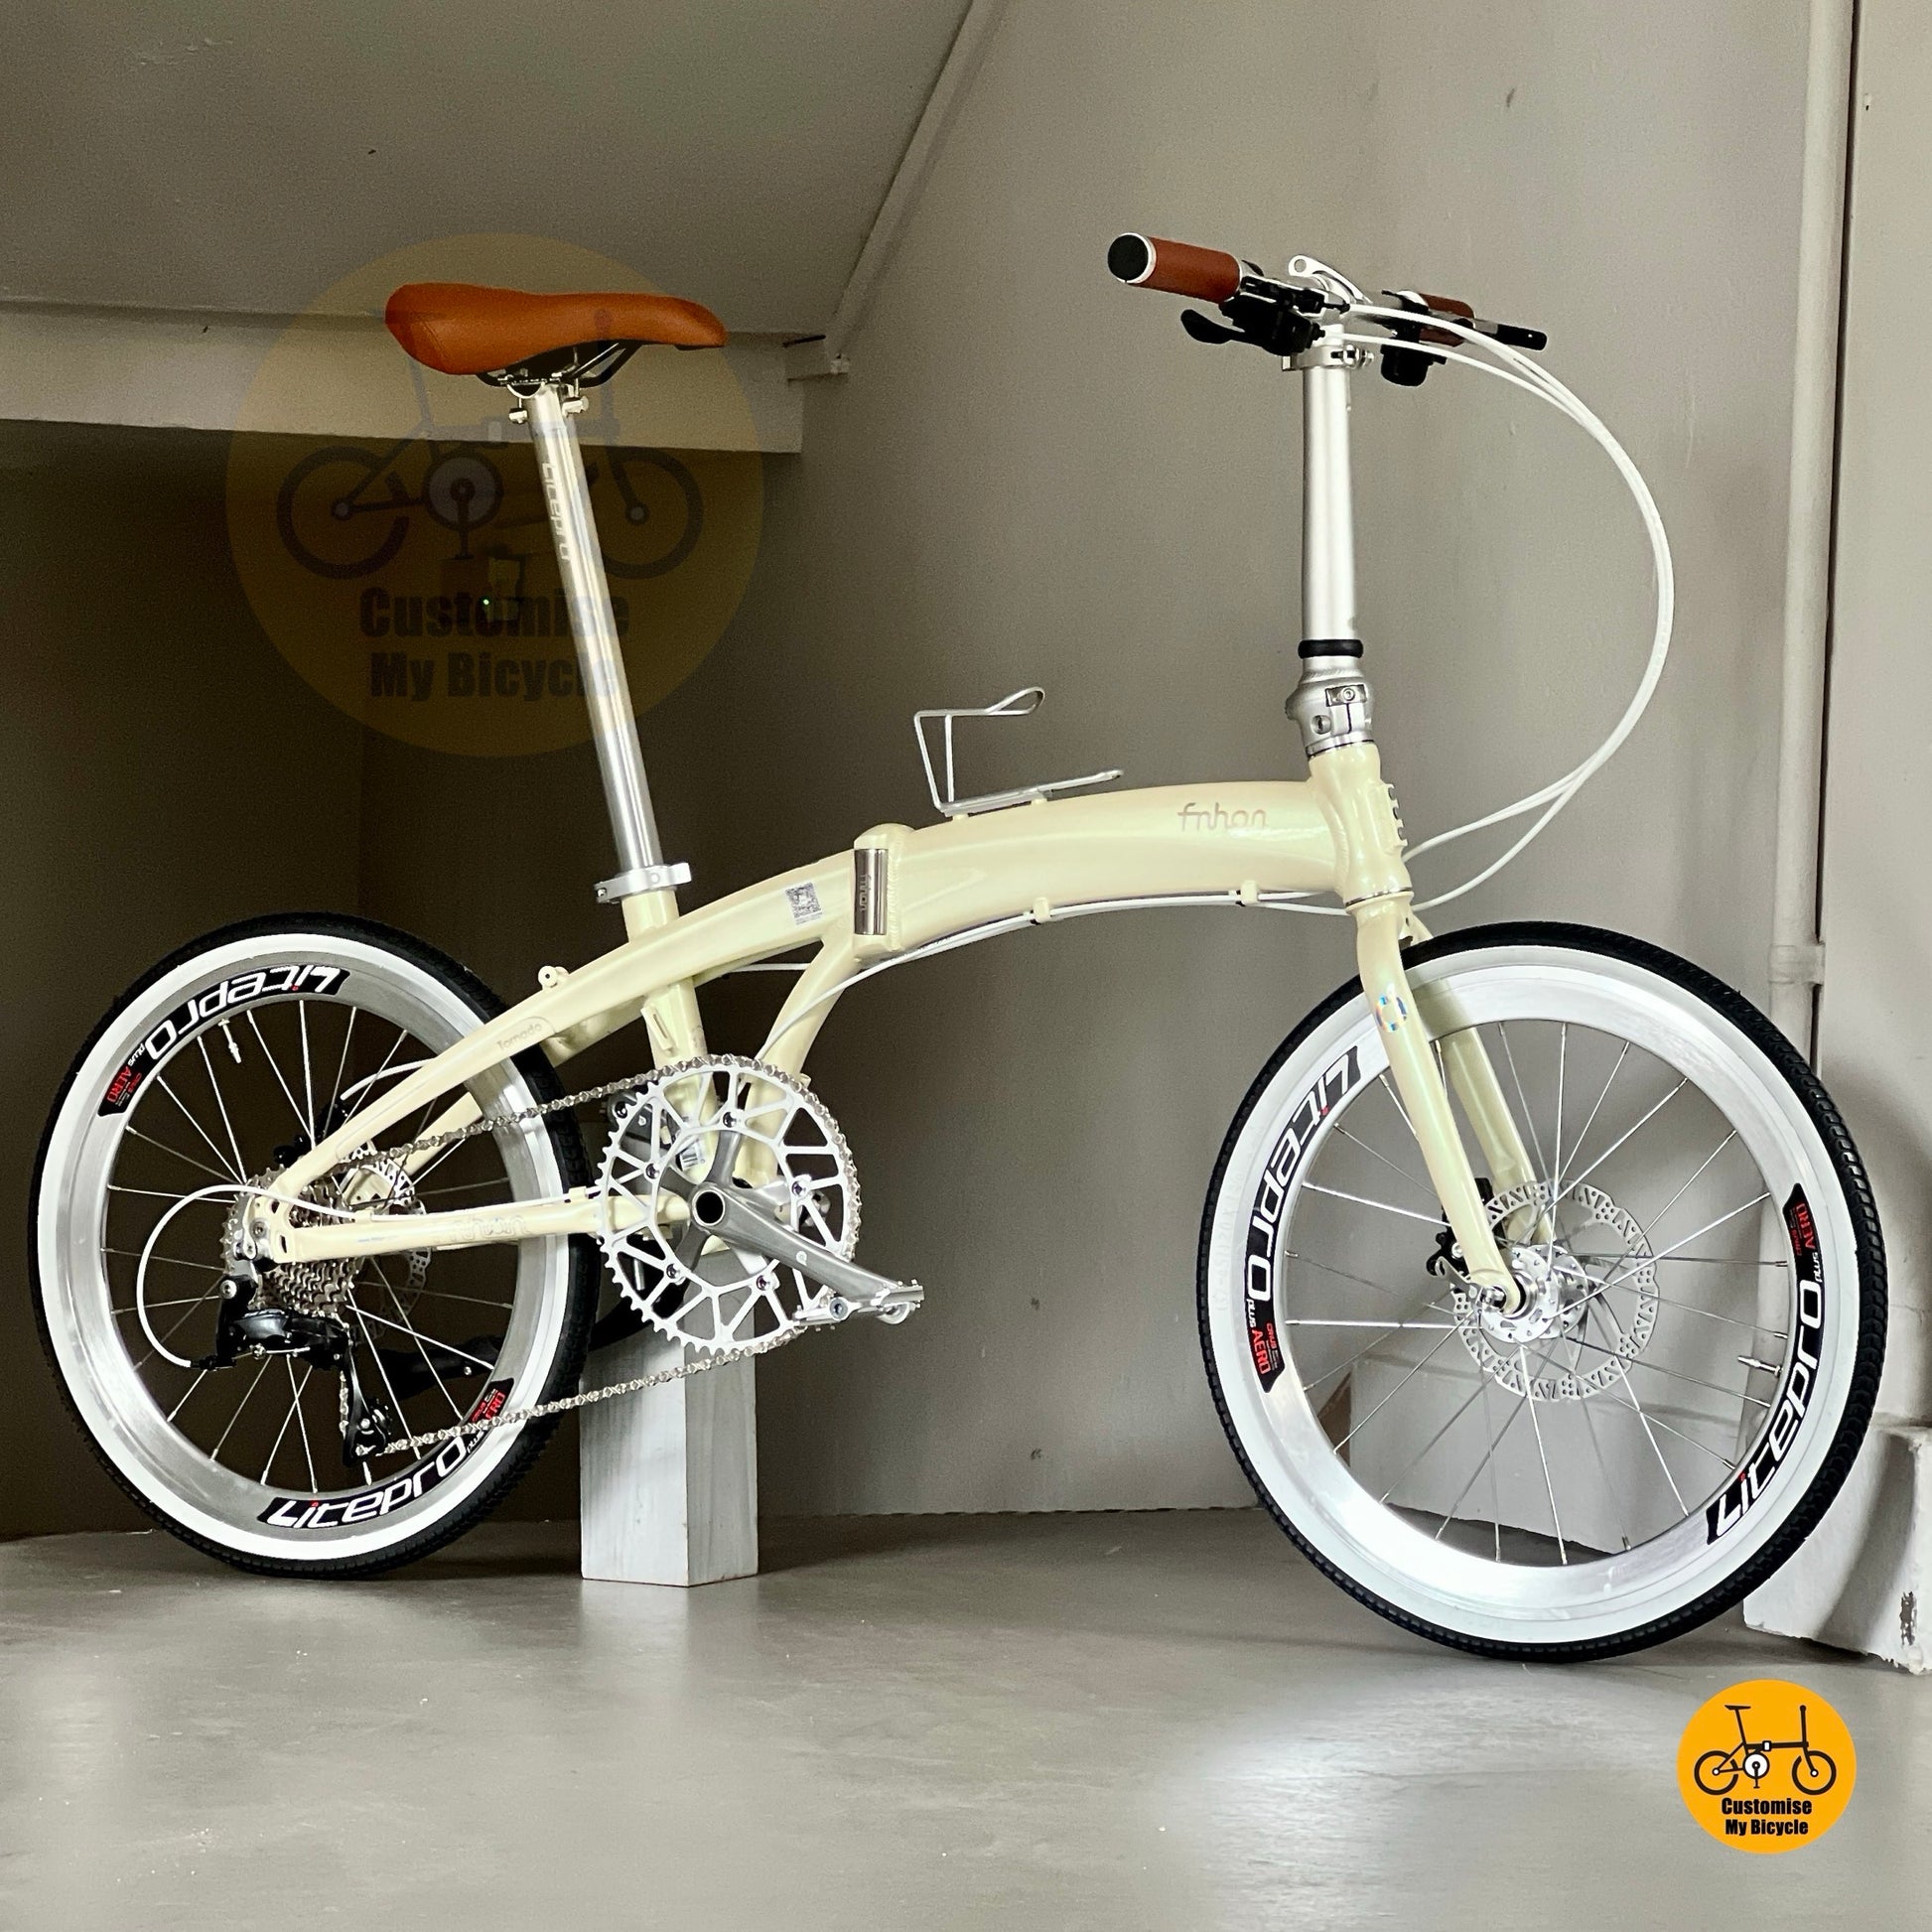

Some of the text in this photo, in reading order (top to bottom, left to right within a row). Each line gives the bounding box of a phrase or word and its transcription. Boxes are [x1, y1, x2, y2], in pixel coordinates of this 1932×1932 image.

[145, 965, 341, 1060] Litepro
[106, 1065, 132, 1102] AERO
[1248, 1054, 1349, 1302] Litepro
[1252, 1328, 1272, 1375] AERO
[1716, 1279, 1823, 1537] Litepro
[1796, 1203, 1816, 1250] AERO
[266, 1435, 468, 1530] Litepro
